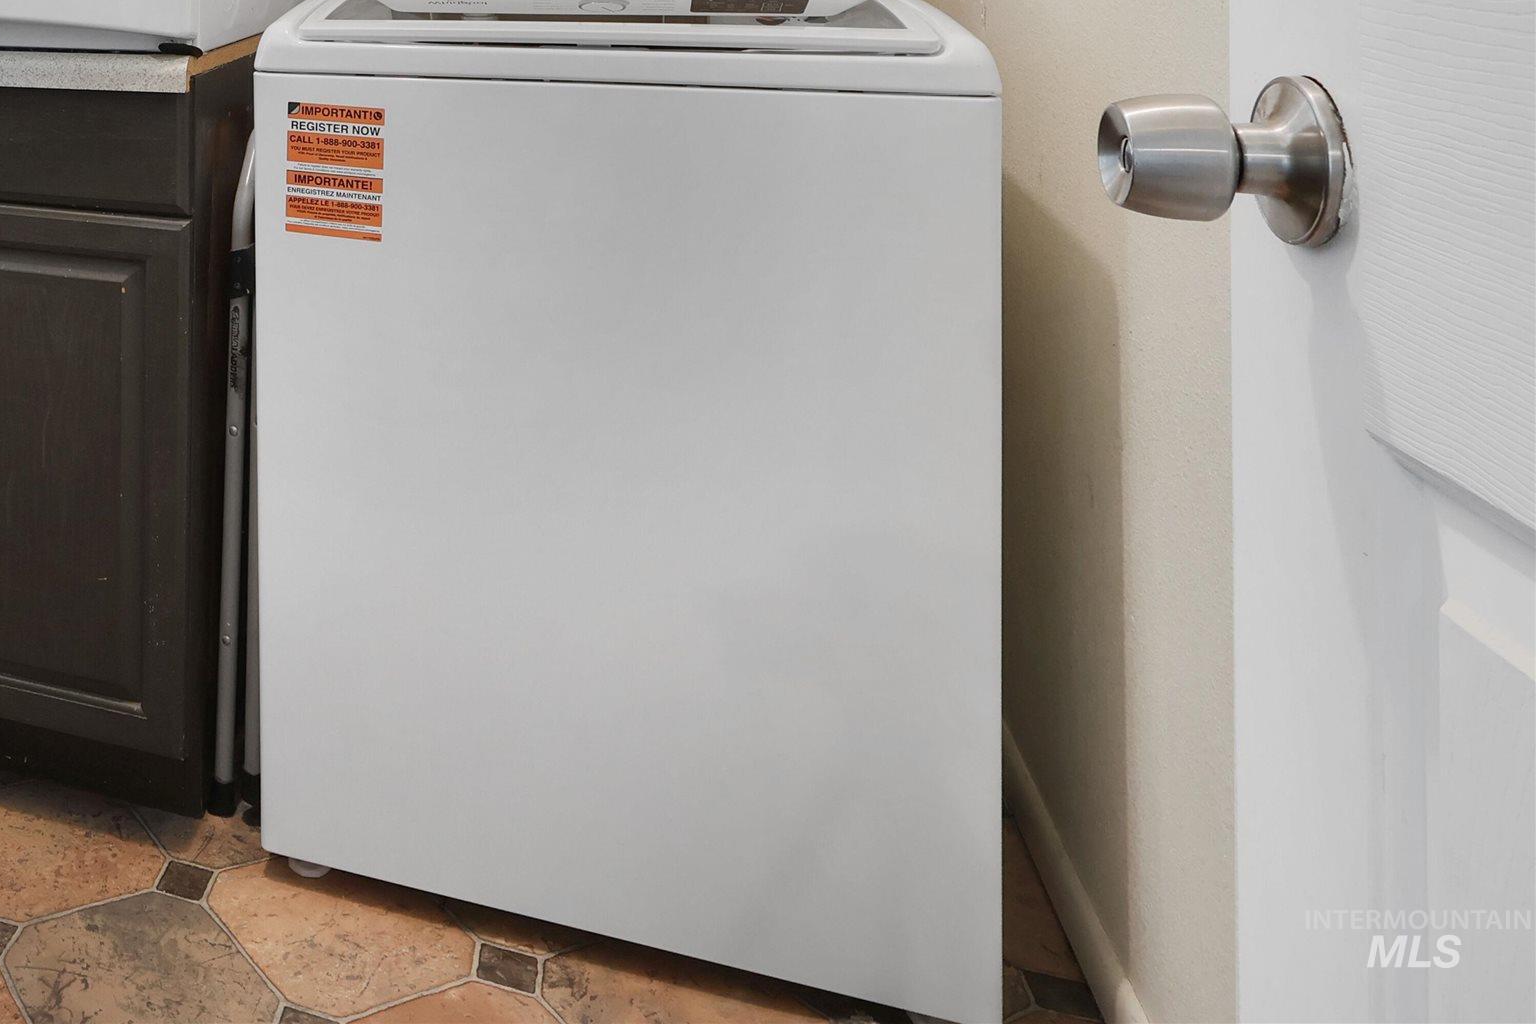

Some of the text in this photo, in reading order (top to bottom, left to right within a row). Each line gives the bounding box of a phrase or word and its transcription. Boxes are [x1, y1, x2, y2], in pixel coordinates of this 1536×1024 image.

[301, 106, 373, 120] IMPORTANT!
[291, 120, 381, 136] REGISTER NOW
[289, 135, 380, 149] CALL 1-888-900-3381
[294, 174, 373, 190] IMPORTANTE!
[287, 186, 381, 201] ENREGISTREZ MAINTENANT
[288, 196, 319, 205] APPELEZ
